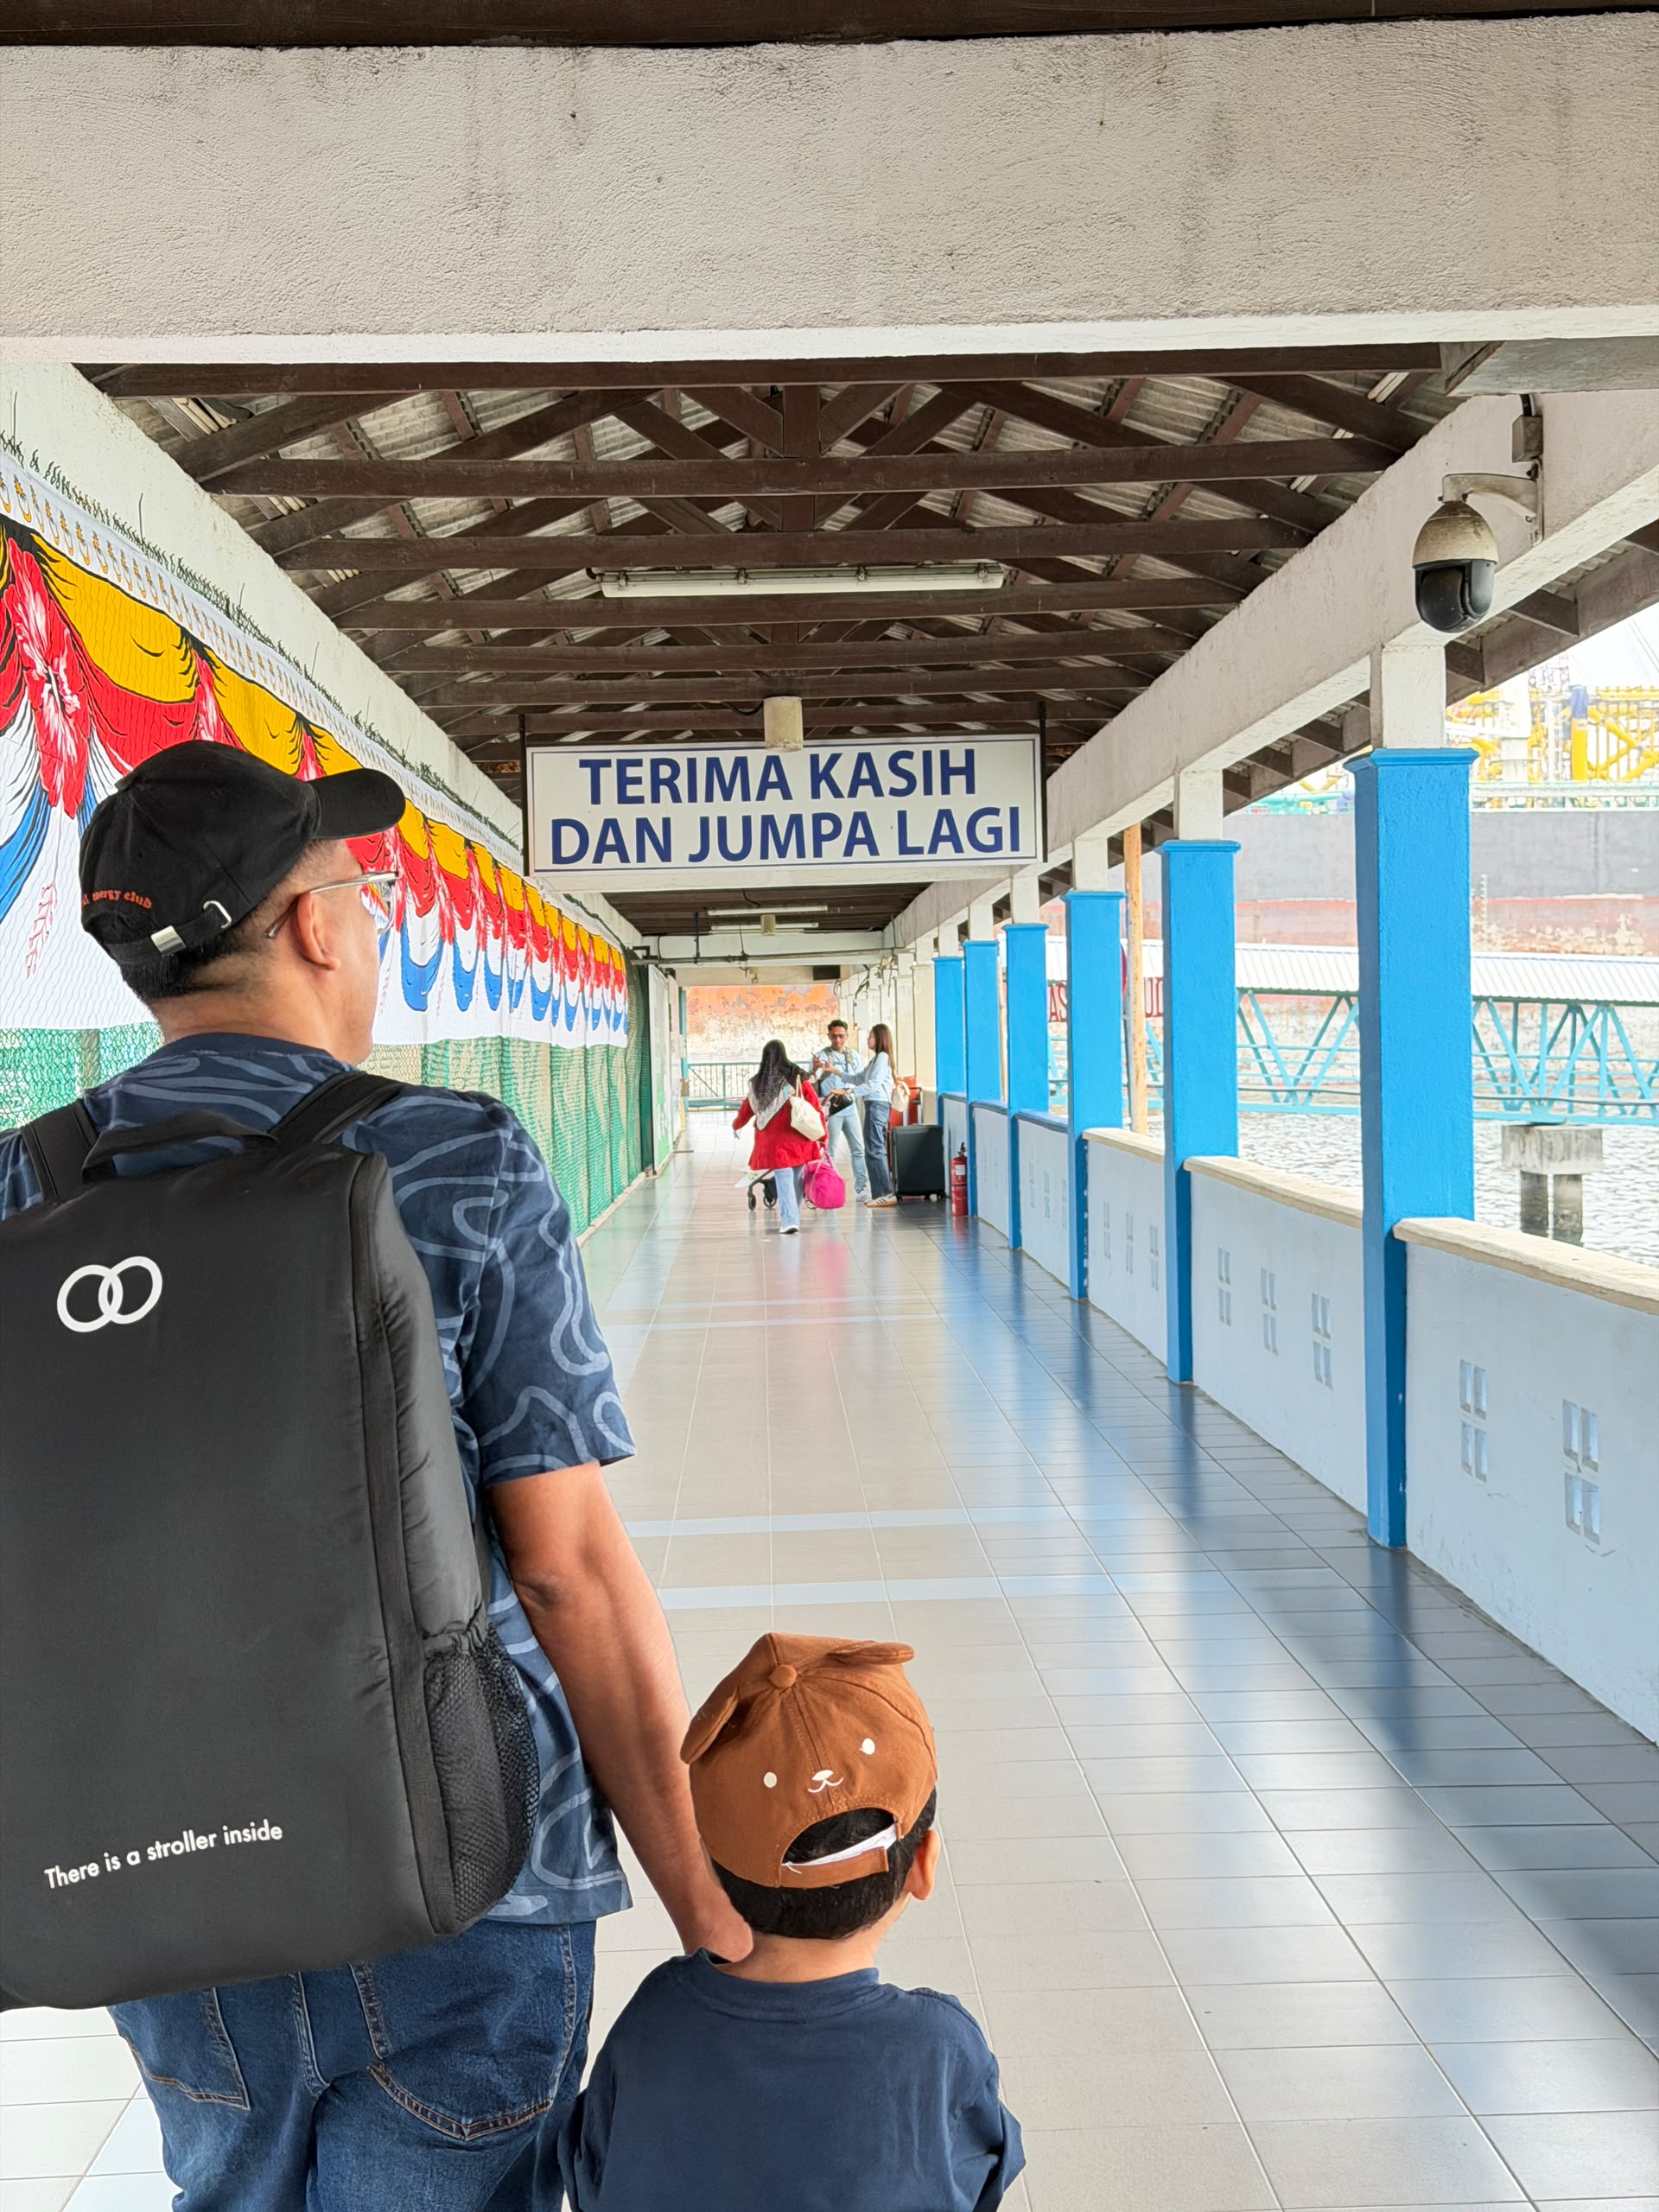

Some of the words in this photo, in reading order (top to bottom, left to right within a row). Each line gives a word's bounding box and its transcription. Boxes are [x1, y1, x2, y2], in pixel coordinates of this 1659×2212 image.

[578, 755, 793, 805] TERIMA
[809, 748, 976, 800] KASIH
[550, 816, 672, 865] DAN
[688, 810, 880, 862] JUMPA
[896, 806, 1021, 855] LAGI
[123, 891, 152, 910] club
[43, 1861, 100, 1889] There
[103, 1852, 122, 1872] is
[126, 1850, 141, 1866] a
[146, 1829, 218, 1861] stroller
[222, 1818, 283, 1846] inside
